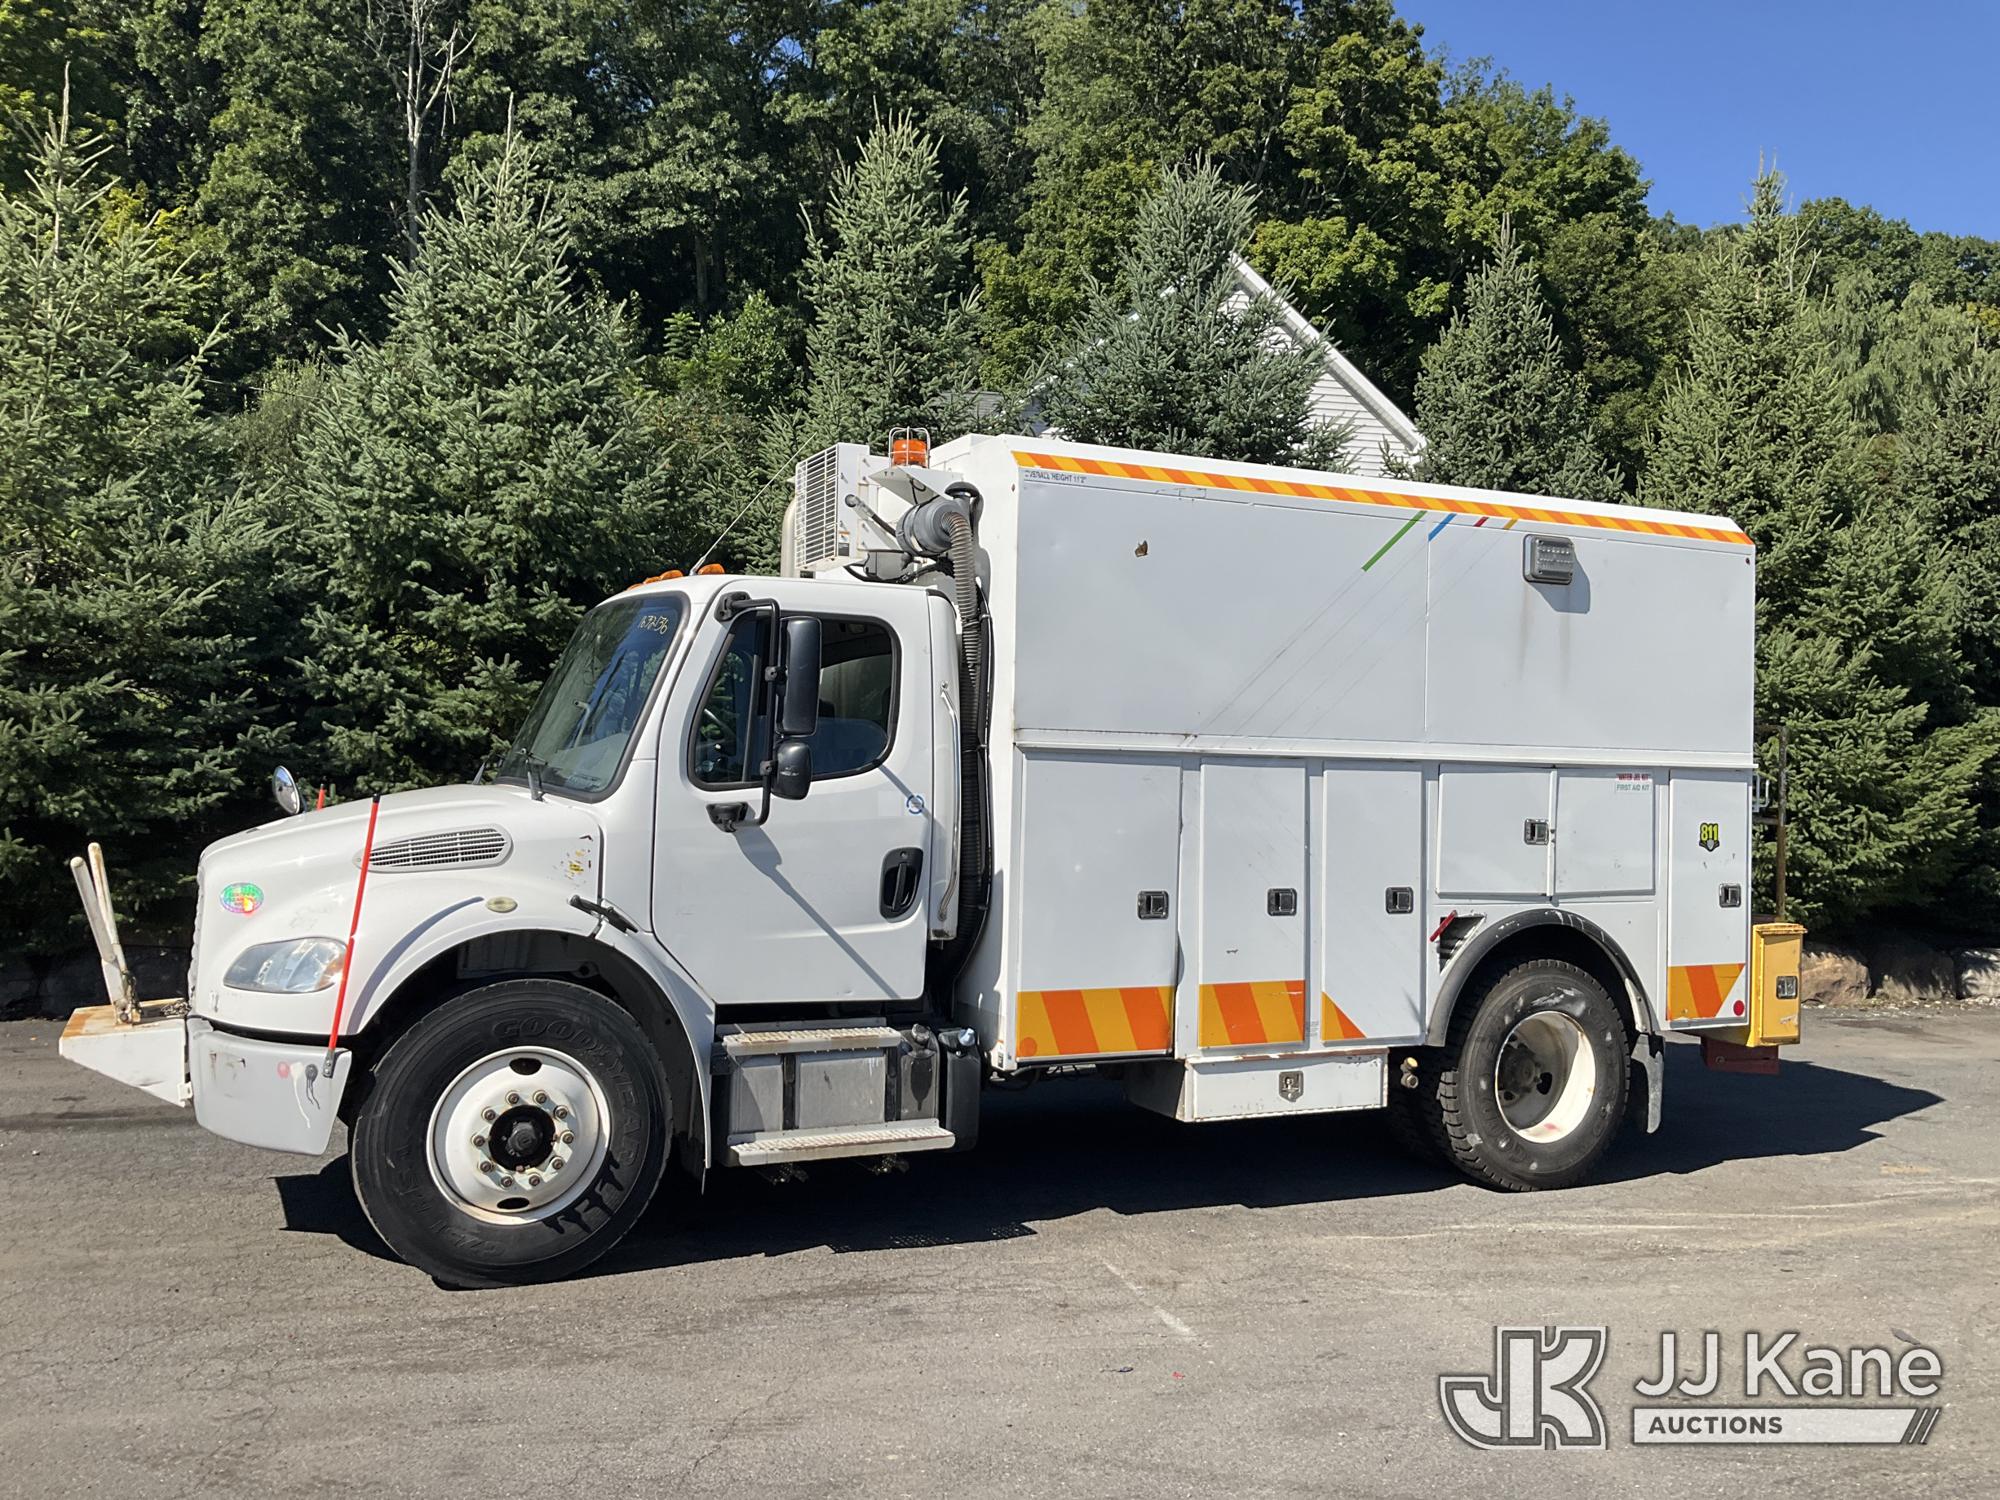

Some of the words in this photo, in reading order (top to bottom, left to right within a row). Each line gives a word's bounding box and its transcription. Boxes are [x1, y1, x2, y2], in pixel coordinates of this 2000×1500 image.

[1051, 473, 1072, 482] HEIGHT
[1617, 783, 1632, 791] FIRST
[1700, 824, 1718, 842] 811
